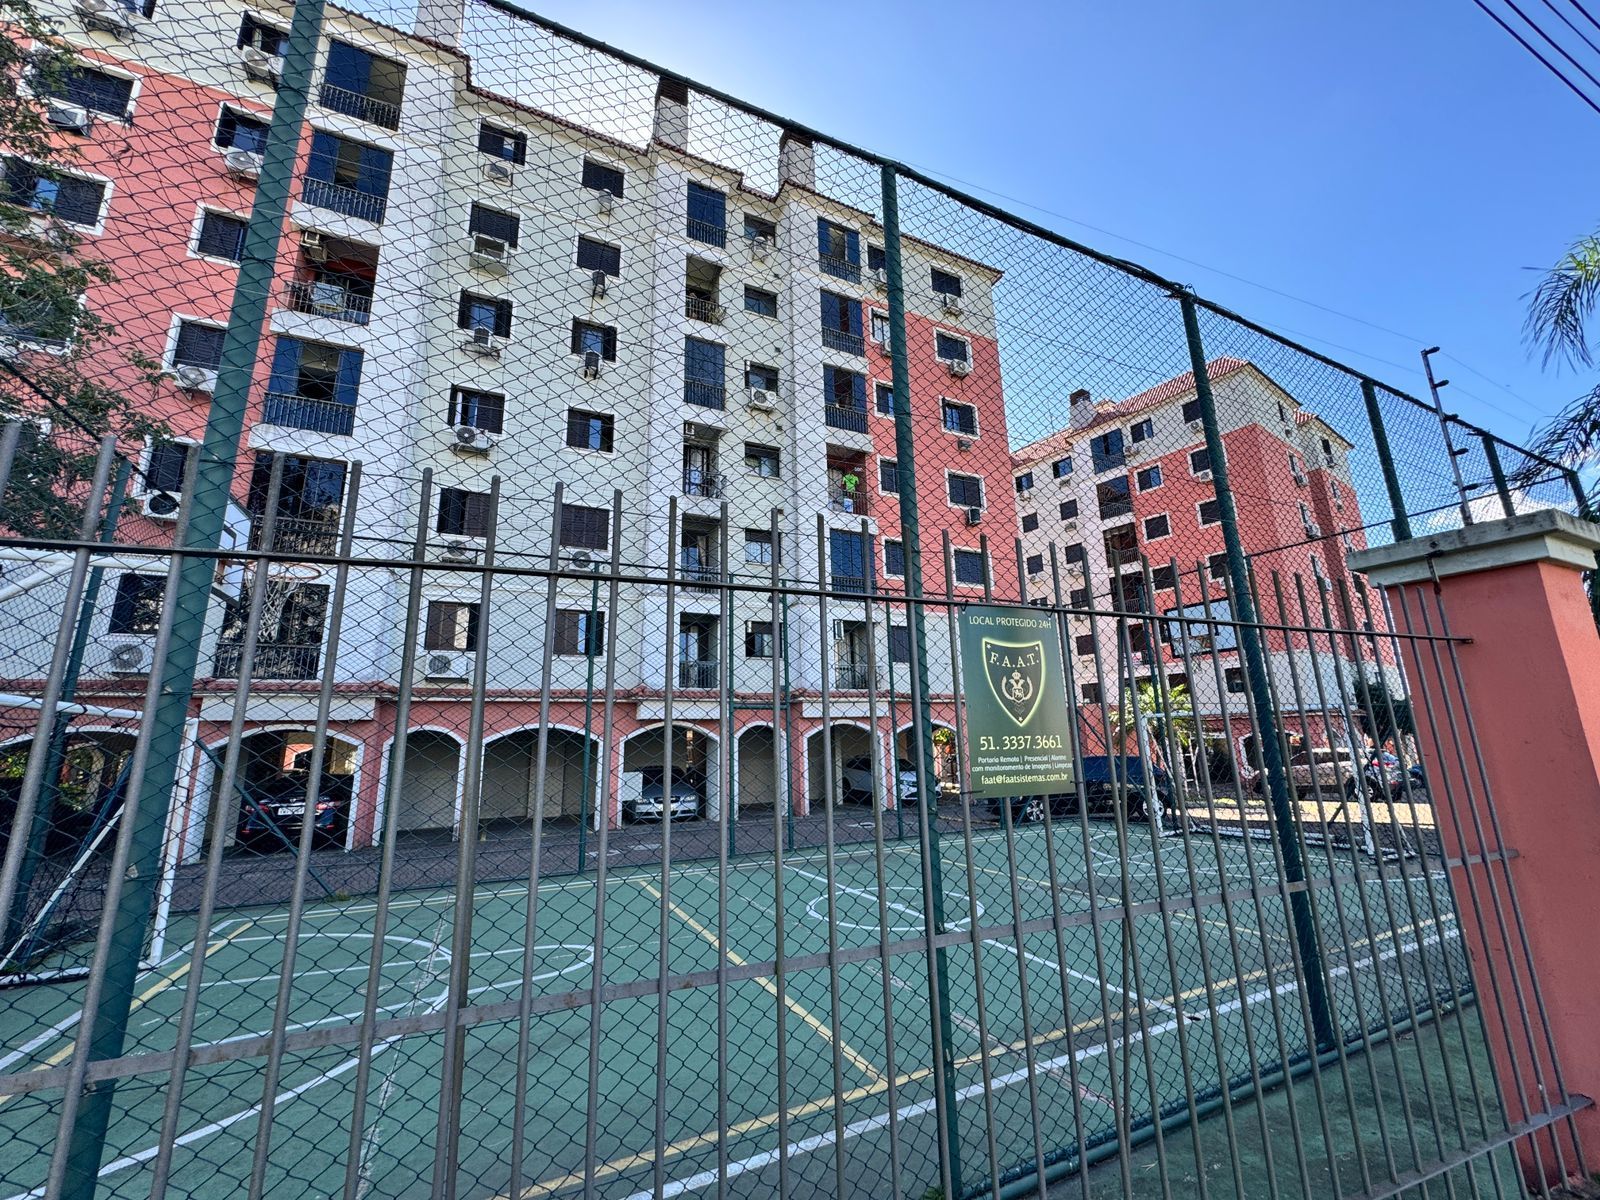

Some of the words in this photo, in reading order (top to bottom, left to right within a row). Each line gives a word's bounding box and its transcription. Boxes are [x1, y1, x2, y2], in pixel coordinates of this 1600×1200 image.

[969, 616, 994, 625] LOCAL
[996, 616, 1037, 628] PROTEGIDO
[1038, 620, 1051, 629] 24H
[1002, 735, 1062, 750] 3337.3661
[981, 772, 1068, 785] faat@faatsistemas.com.br
